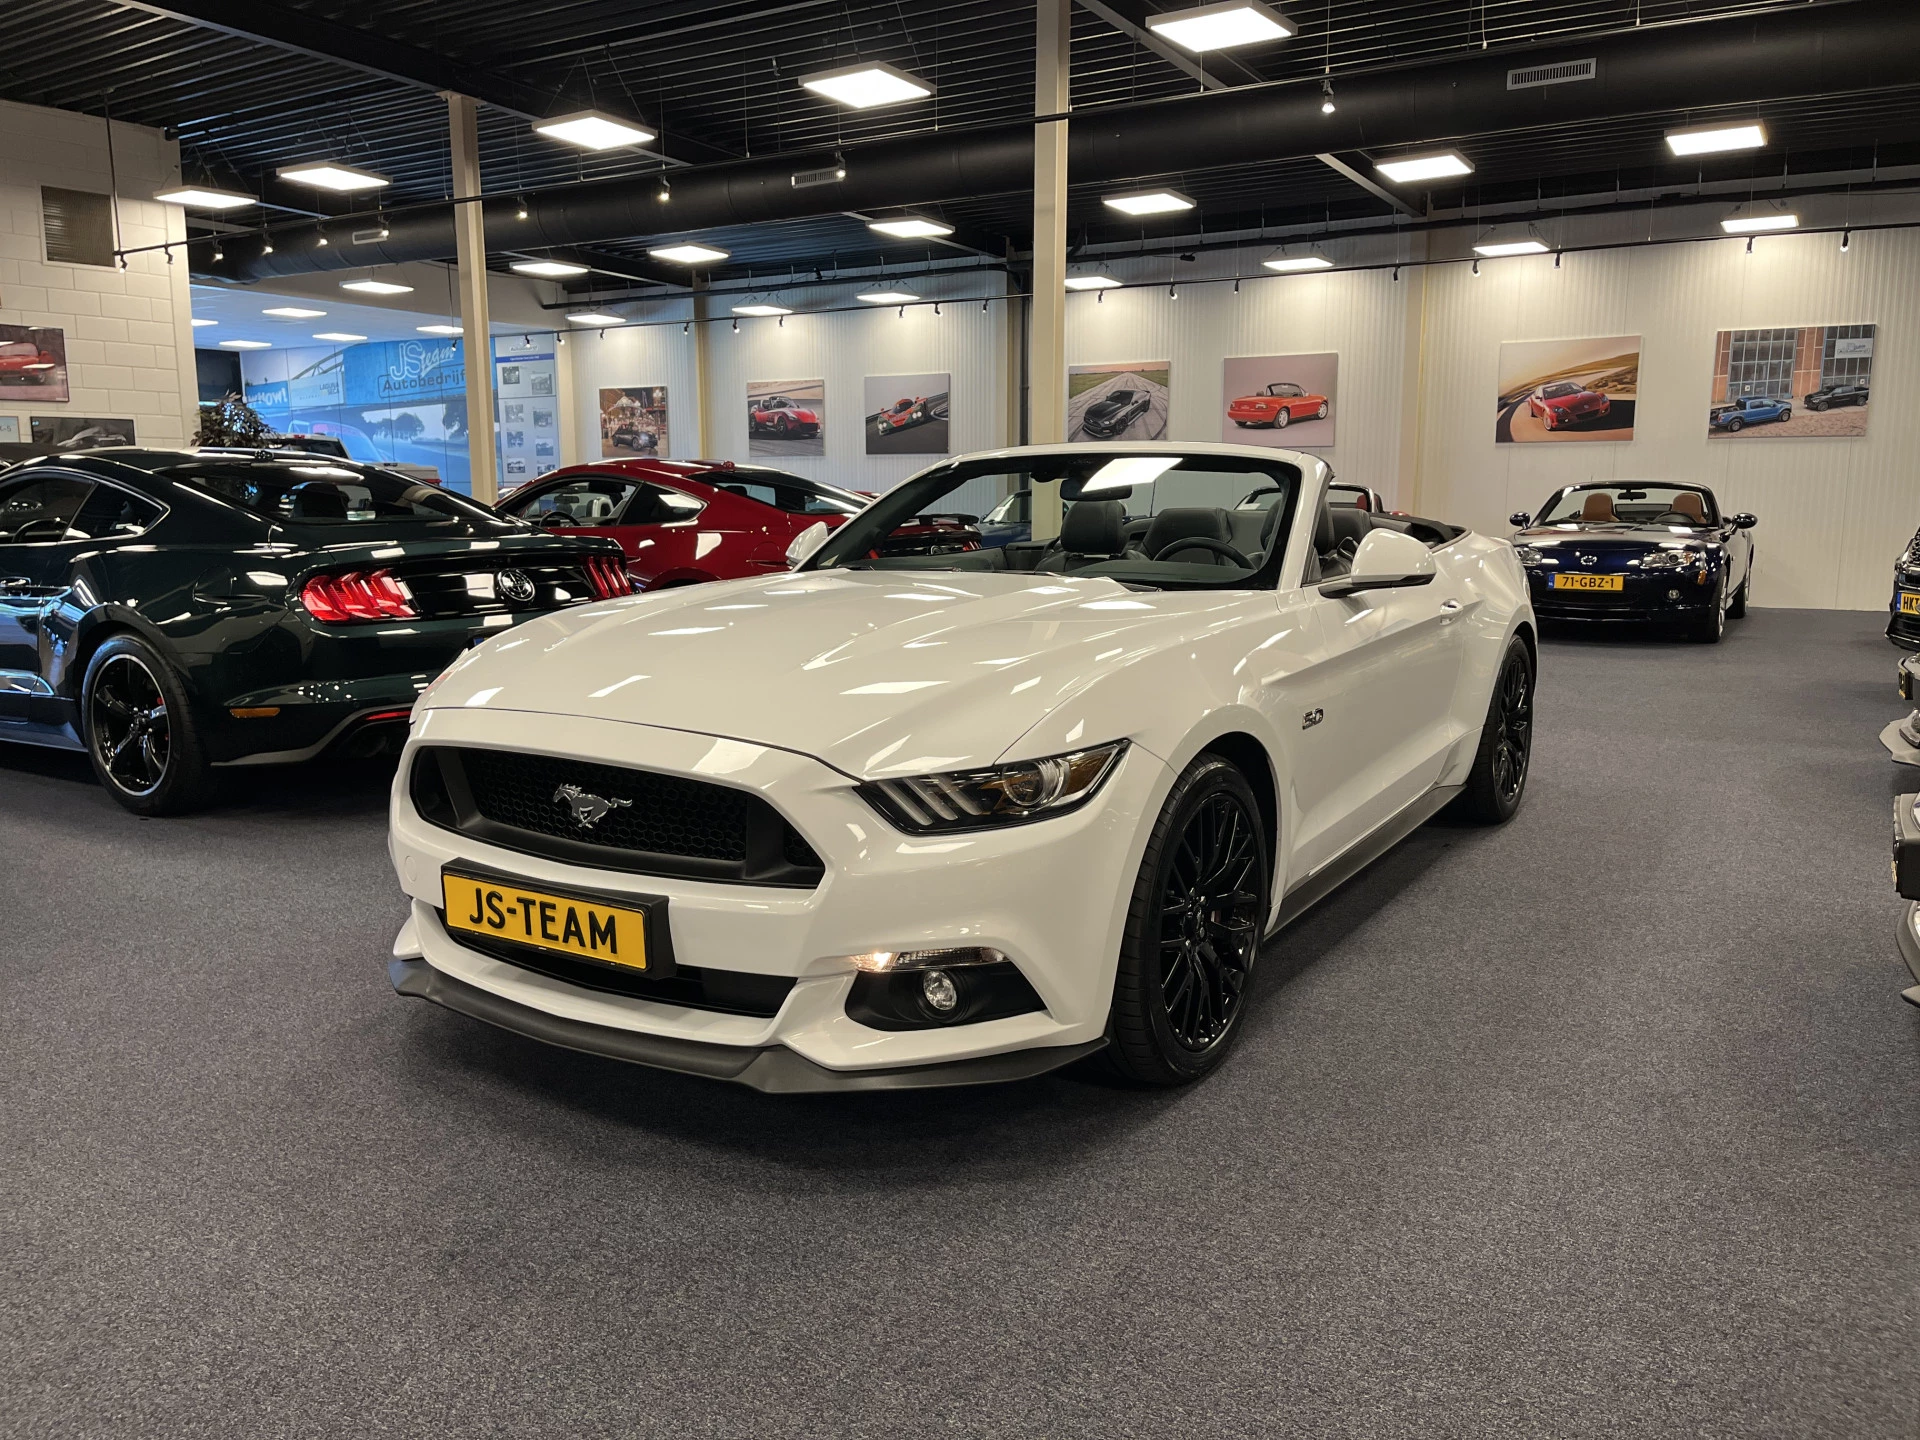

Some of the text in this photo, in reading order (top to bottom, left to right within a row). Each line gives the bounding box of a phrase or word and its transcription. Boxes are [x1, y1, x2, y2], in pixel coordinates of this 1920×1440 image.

[382, 369, 467, 392] Autobedrijf
[1562, 576, 1614, 588] 71-GBZ-1
[469, 887, 618, 955] JS-TEAM
